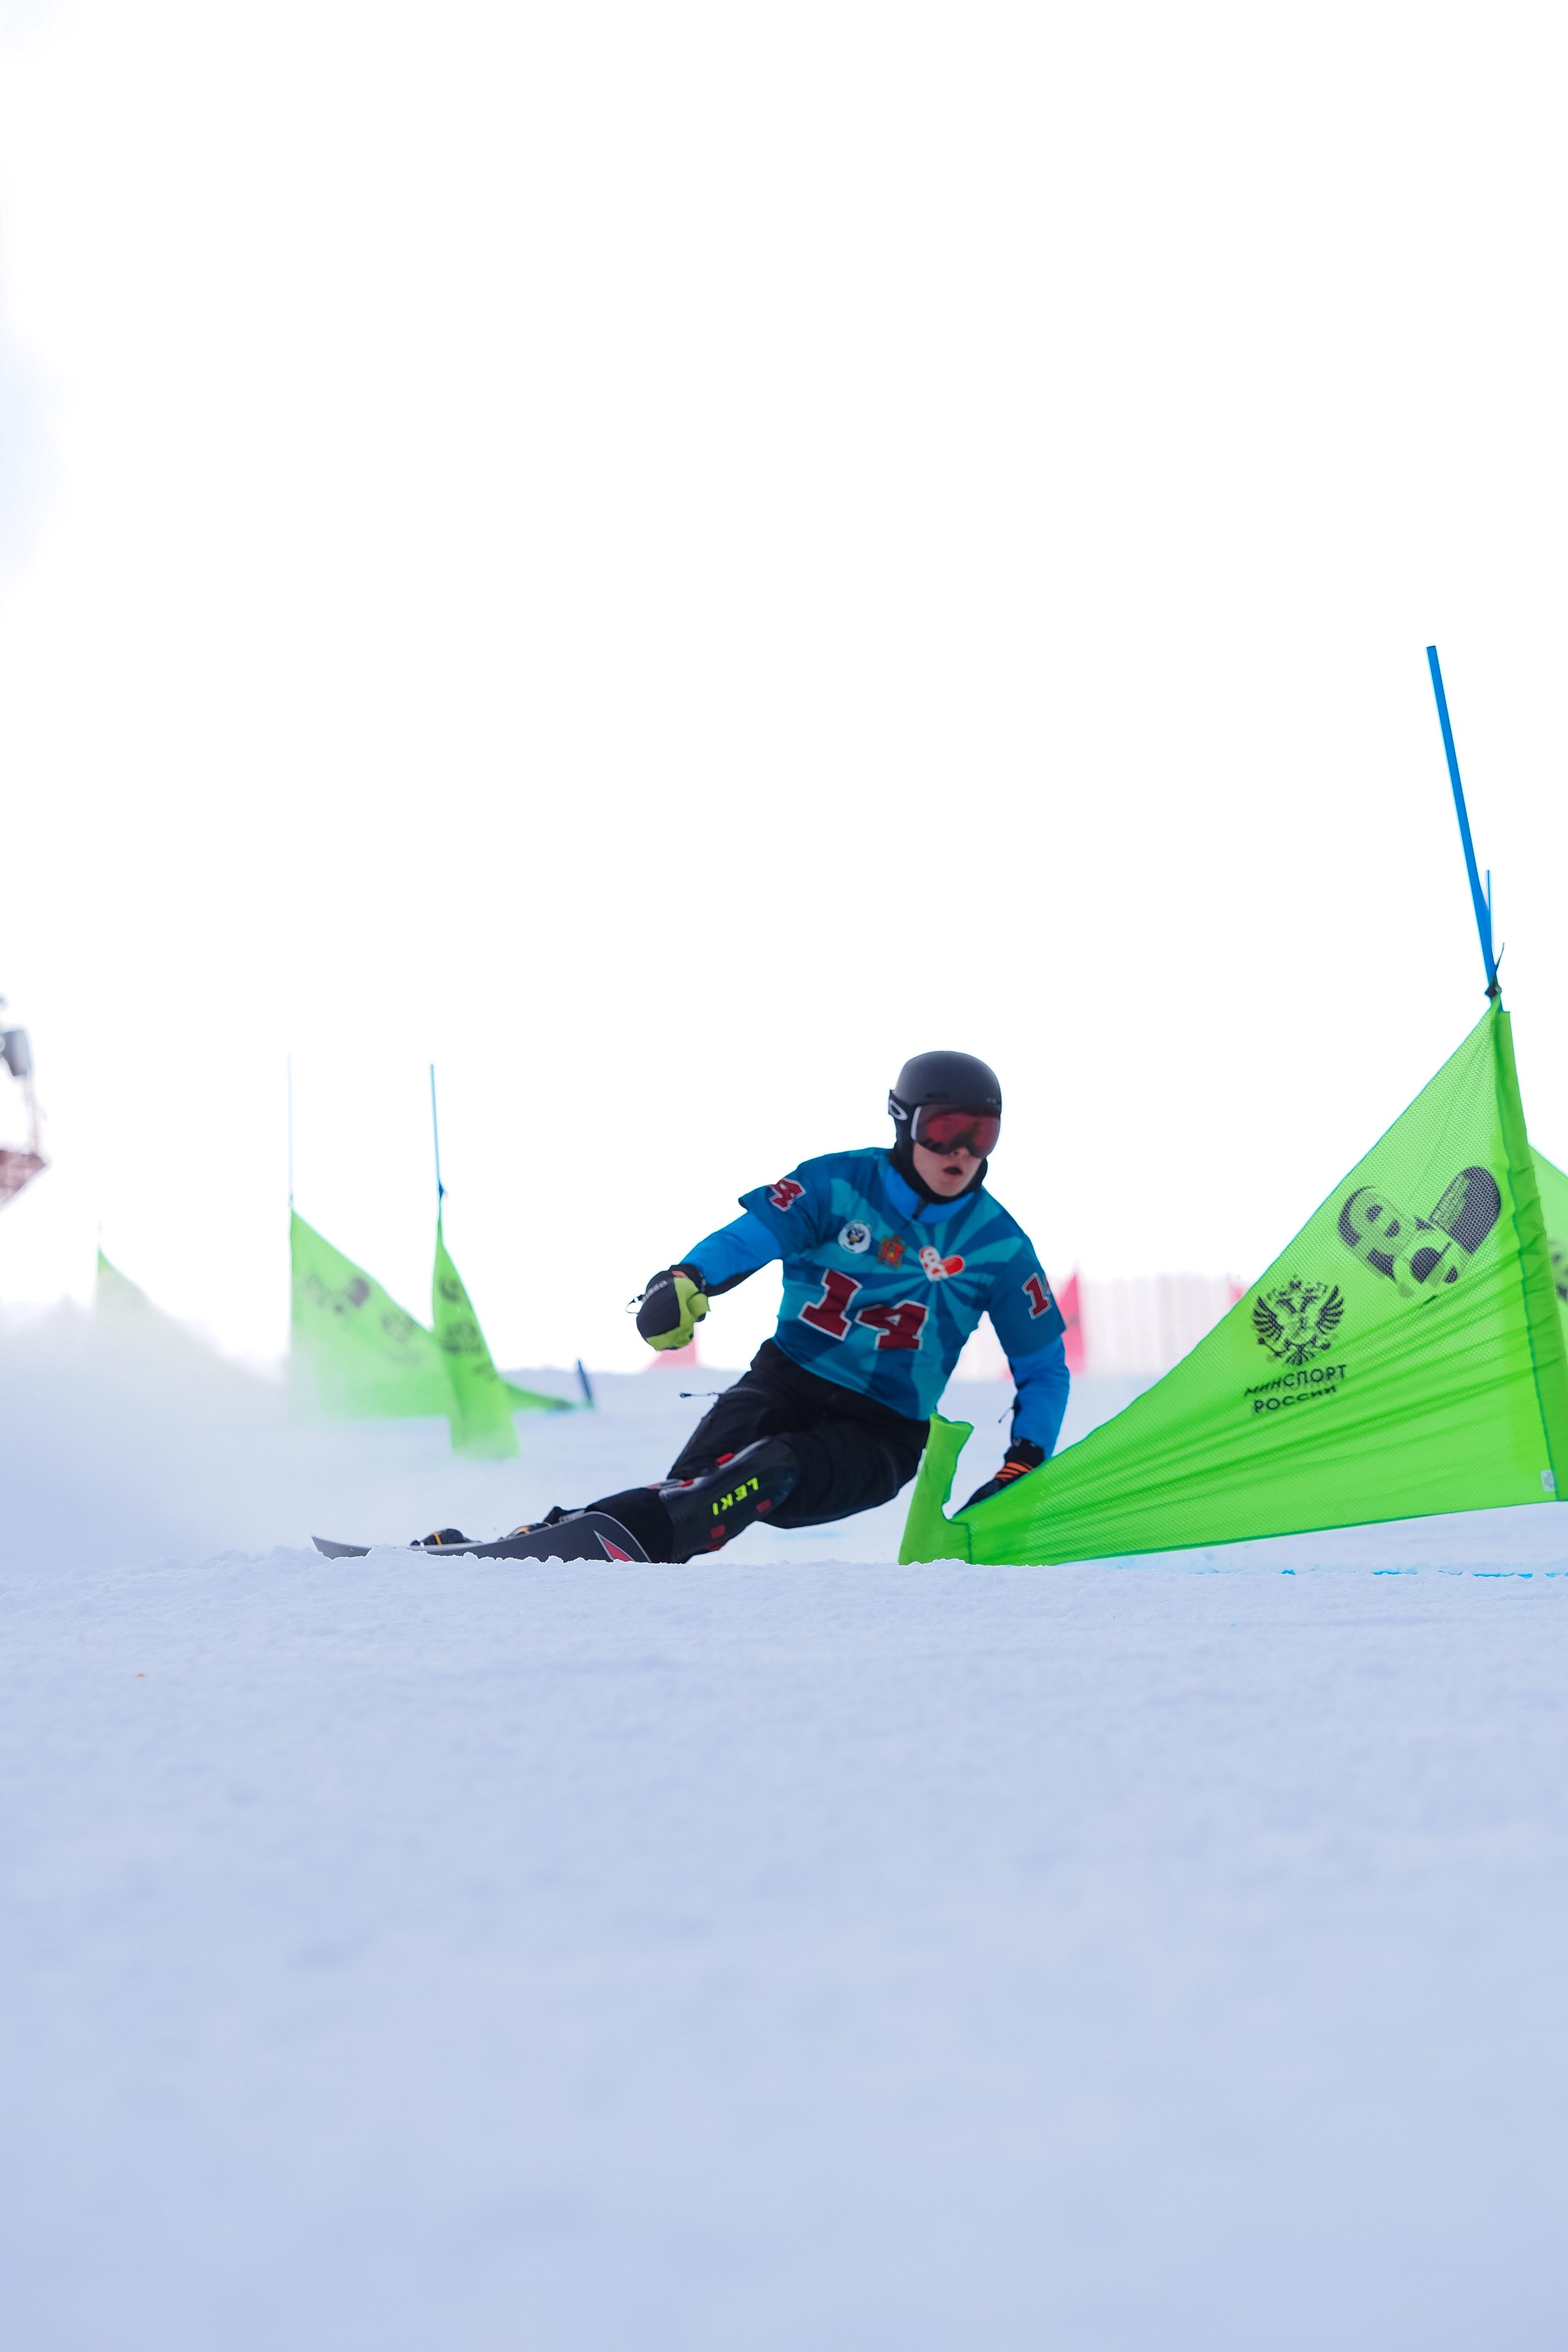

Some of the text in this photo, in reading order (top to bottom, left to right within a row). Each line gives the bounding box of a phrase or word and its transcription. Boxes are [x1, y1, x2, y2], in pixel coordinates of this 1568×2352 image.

[798, 1268, 930, 1351] 14
[1021, 1272, 1052, 1320] 1
[1243, 1364, 1346, 1397] МИНСПОРТ
[1254, 1385, 1336, 1413] РОССИИ
[712, 1477, 759, 1516] LEKI
